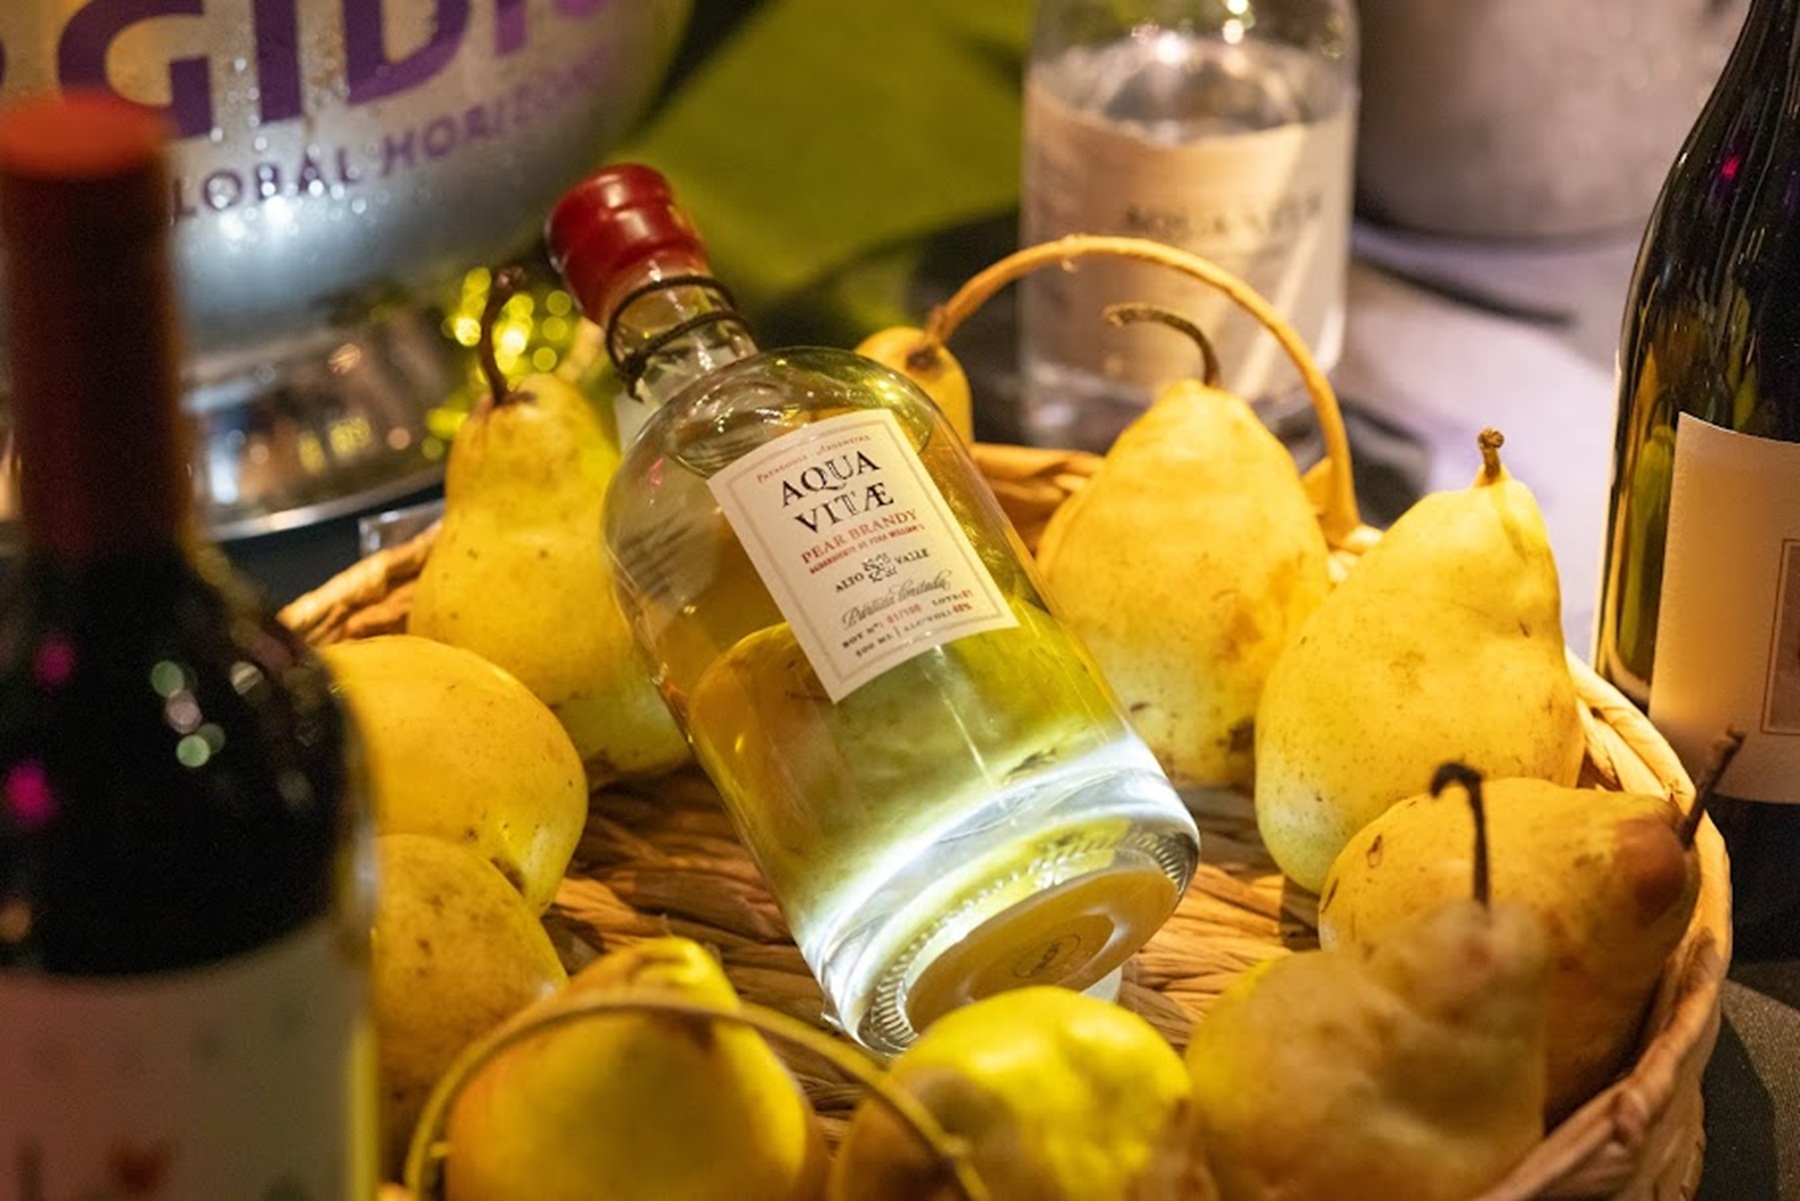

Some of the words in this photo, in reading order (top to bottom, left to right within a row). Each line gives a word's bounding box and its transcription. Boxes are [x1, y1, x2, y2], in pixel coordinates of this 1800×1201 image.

[170, 145, 366, 222] LOBAL
[782, 449, 881, 508] AQUA
[801, 534, 846, 564] PEAR
[848, 509, 918, 541] BRANDY
[835, 572, 865, 593] ALTO
[894, 548, 930, 565] VALLE
